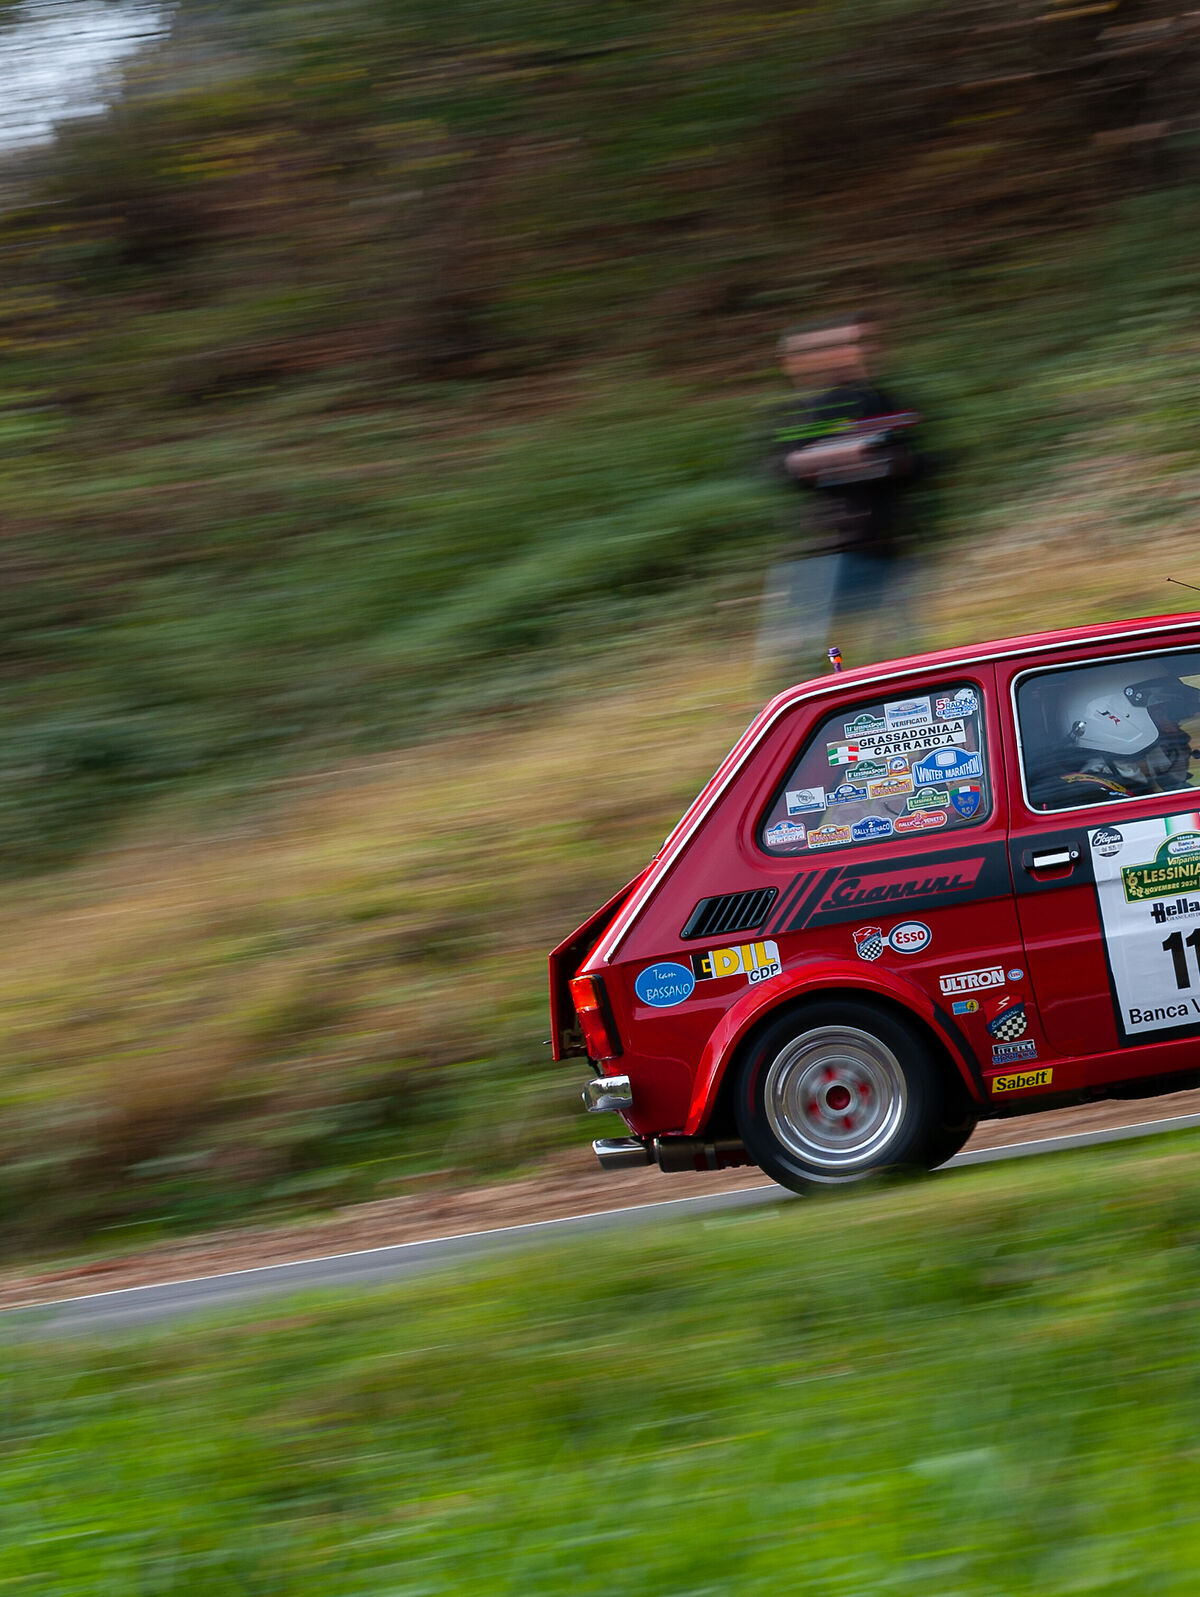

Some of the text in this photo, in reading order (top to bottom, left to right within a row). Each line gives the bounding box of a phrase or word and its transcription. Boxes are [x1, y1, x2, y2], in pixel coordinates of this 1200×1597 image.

[891, 716, 928, 728] VERIFICATO
[860, 722, 962, 747] GRASSADONIA.A
[874, 735, 954, 755] CARRARO.A
[916, 756, 980, 783] WINTER MARATHON
[822, 872, 974, 909] Giannini
[692, 942, 776, 981] EDIL
[653, 968, 677, 980] Team
[750, 963, 781, 984] CDP
[939, 969, 1006, 993] ULTRON
[646, 982, 691, 1001] BASSANO
[1128, 1002, 1188, 1025] Banca
[996, 1072, 1048, 1091] Sabelt
